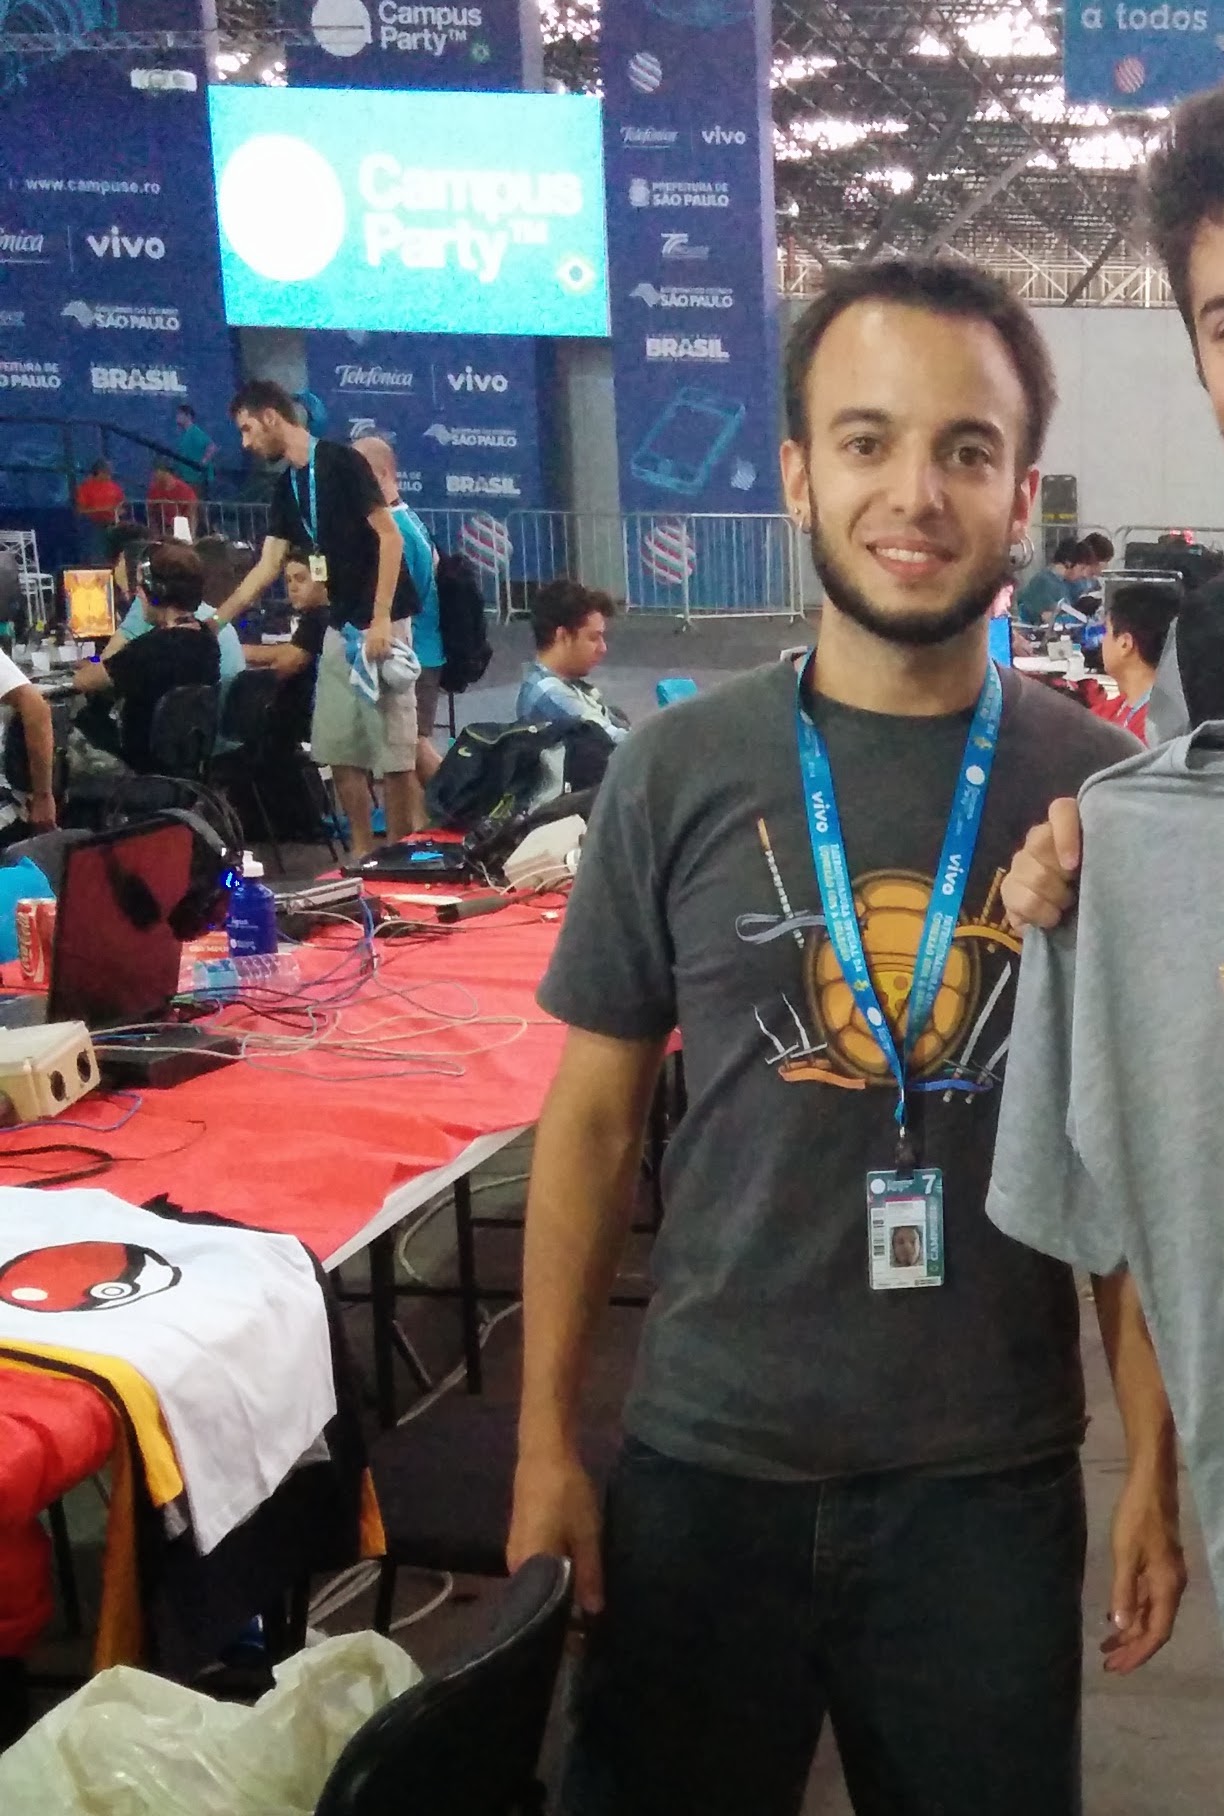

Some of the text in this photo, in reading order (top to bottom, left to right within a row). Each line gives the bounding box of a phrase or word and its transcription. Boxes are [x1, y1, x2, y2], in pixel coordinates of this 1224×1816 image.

[378, 0, 482, 31] Campus
[1081, 4, 1208, 31] a todos
[380, 26, 448, 56] Party
[701, 125, 747, 145] vivo
[358, 153, 584, 223] Campus
[87, 226, 166, 260] vivo
[364, 210, 511, 284] Party
[130, 313, 180, 331] PAULO
[645, 337, 731, 358] BRASIL
[11, 374, 62, 389] PAULO
[91, 366, 188, 391] BRASIL
[447, 365, 508, 393] vivo
[445, 475, 521, 495] BRASIL
[811, 790, 829, 833] vivo
[941, 853, 965, 896] vivo
[921, 1174, 936, 1195] 7
